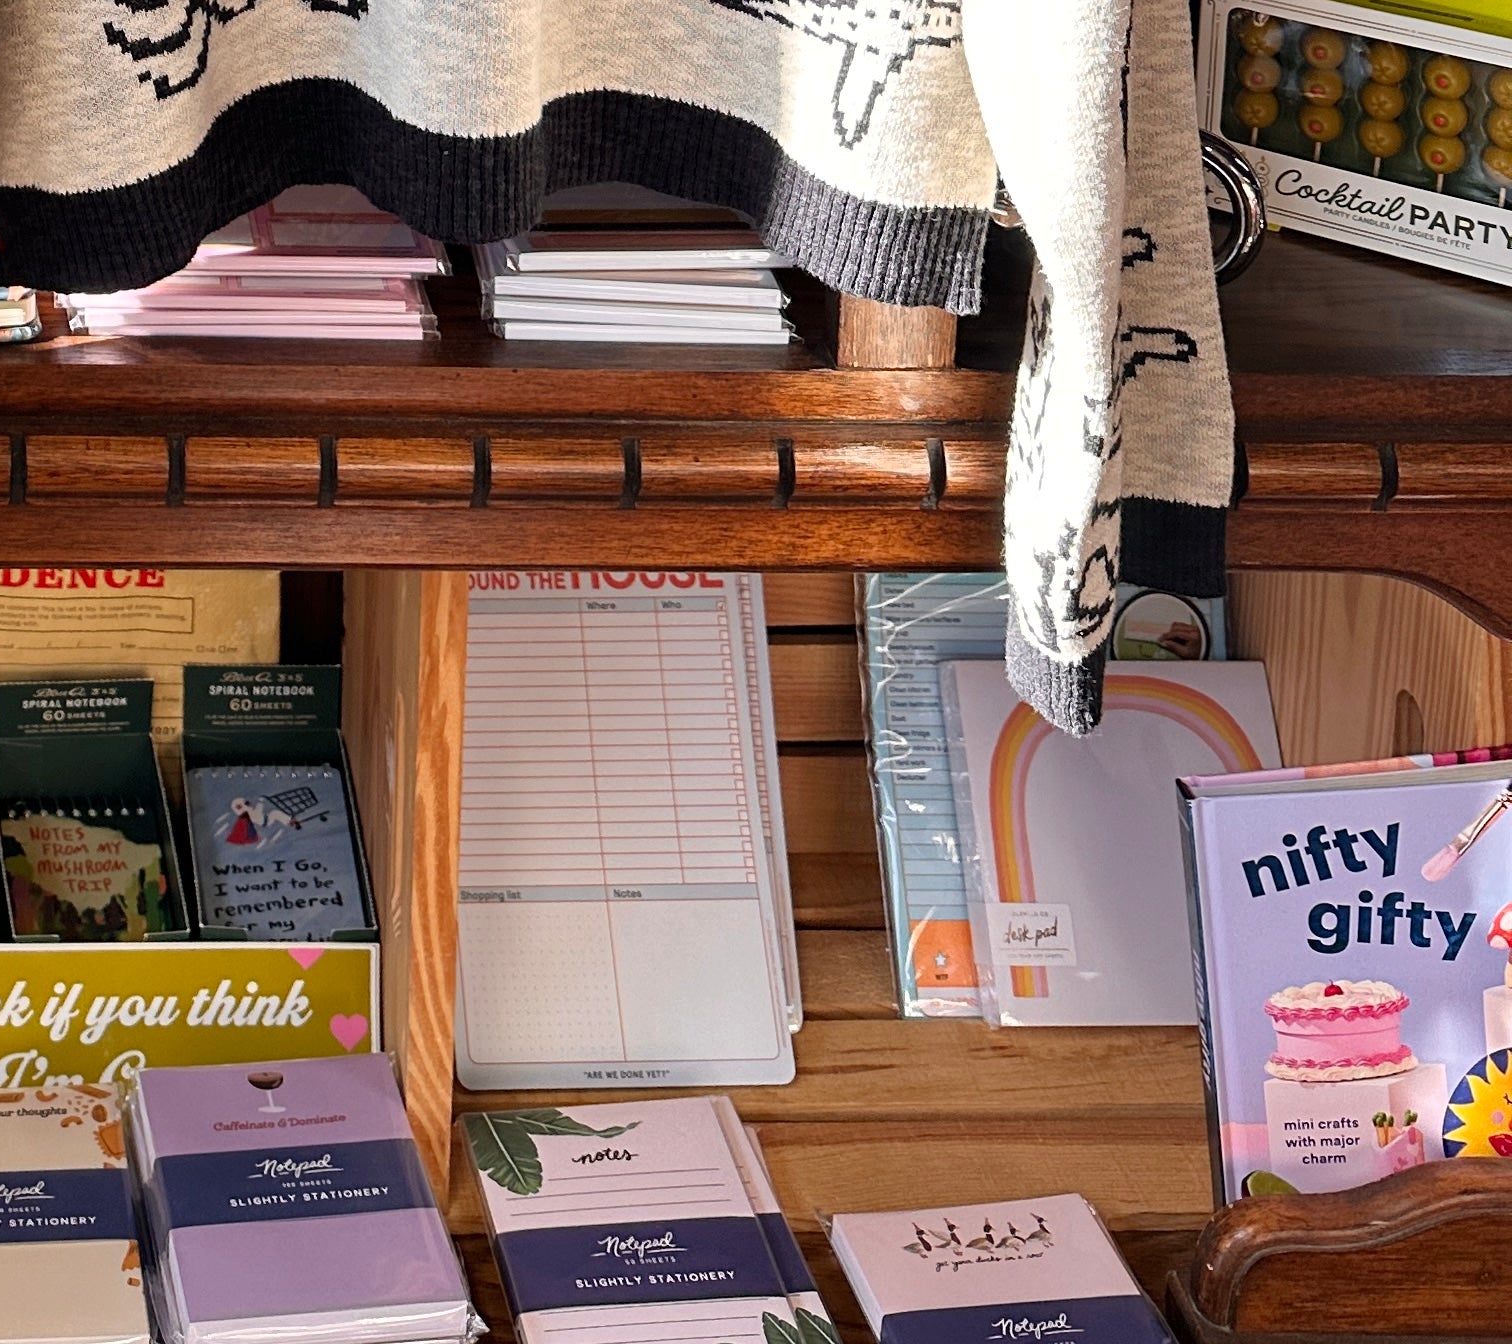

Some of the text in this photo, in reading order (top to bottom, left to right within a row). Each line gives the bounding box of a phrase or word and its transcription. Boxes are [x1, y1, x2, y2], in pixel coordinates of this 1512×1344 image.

[1275, 169, 1405, 222] Cocktail
[1323, 207, 1351, 221] PARTY
[1352, 214, 1391, 230] CANDLES
[1398, 226, 1435, 241] BOUGIES
[1437, 235, 1449, 244] DE
[526, 573, 566, 590] THE
[586, 600, 616, 610] Where
[661, 600, 682, 609] Who
[208, 685, 315, 696] SPIRAL NOTEBOOK
[22, 697, 128, 709] SPIRAL NOTEBOOK
[229, 698, 252, 711] 60
[42, 710, 65, 722] 60
[30, 827, 85, 841] NOTES
[42, 841, 122, 857] FROM MY
[38, 860, 128, 875] MUSHROOM
[212, 863, 264, 876] When
[272, 860, 286, 872] I
[1241, 822, 1400, 898] nifty
[63, 878, 112, 893] TRIP
[214, 876, 334, 896] I want to be
[613, 889, 642, 898] Notes
[461, 890, 521, 902] Shopping list
[214, 891, 343, 918] remembered
[269, 920, 295, 932] my
[1003, 917, 1058, 946] desk pad
[1307, 890, 1477, 961] gifty
[40, 982, 84, 1042] if
[79, 996, 180, 1045] you
[187, 979, 313, 1027] think
[606, 1070, 644, 1079] WE DONE
[16, 1107, 68, 1118] thoughts
[213, 1113, 346, 1132] Caffeinate Dominate
[1284, 1117, 1359, 1130] mini crafts
[1286, 1134, 1360, 1151] with major
[572, 1147, 640, 1164] notes
[1302, 1152, 1346, 1165] charm
[256, 1154, 335, 1178] Notepad
[229, 1186, 389, 1208] SLIGHTLY STATIONERY
[9, 1216, 97, 1228] STATIONERY
[597, 1231, 677, 1258] Notepad
[575, 1270, 735, 1288] SLIGHTLY STATIONERY
[991, 1313, 1072, 1340] Notepad
